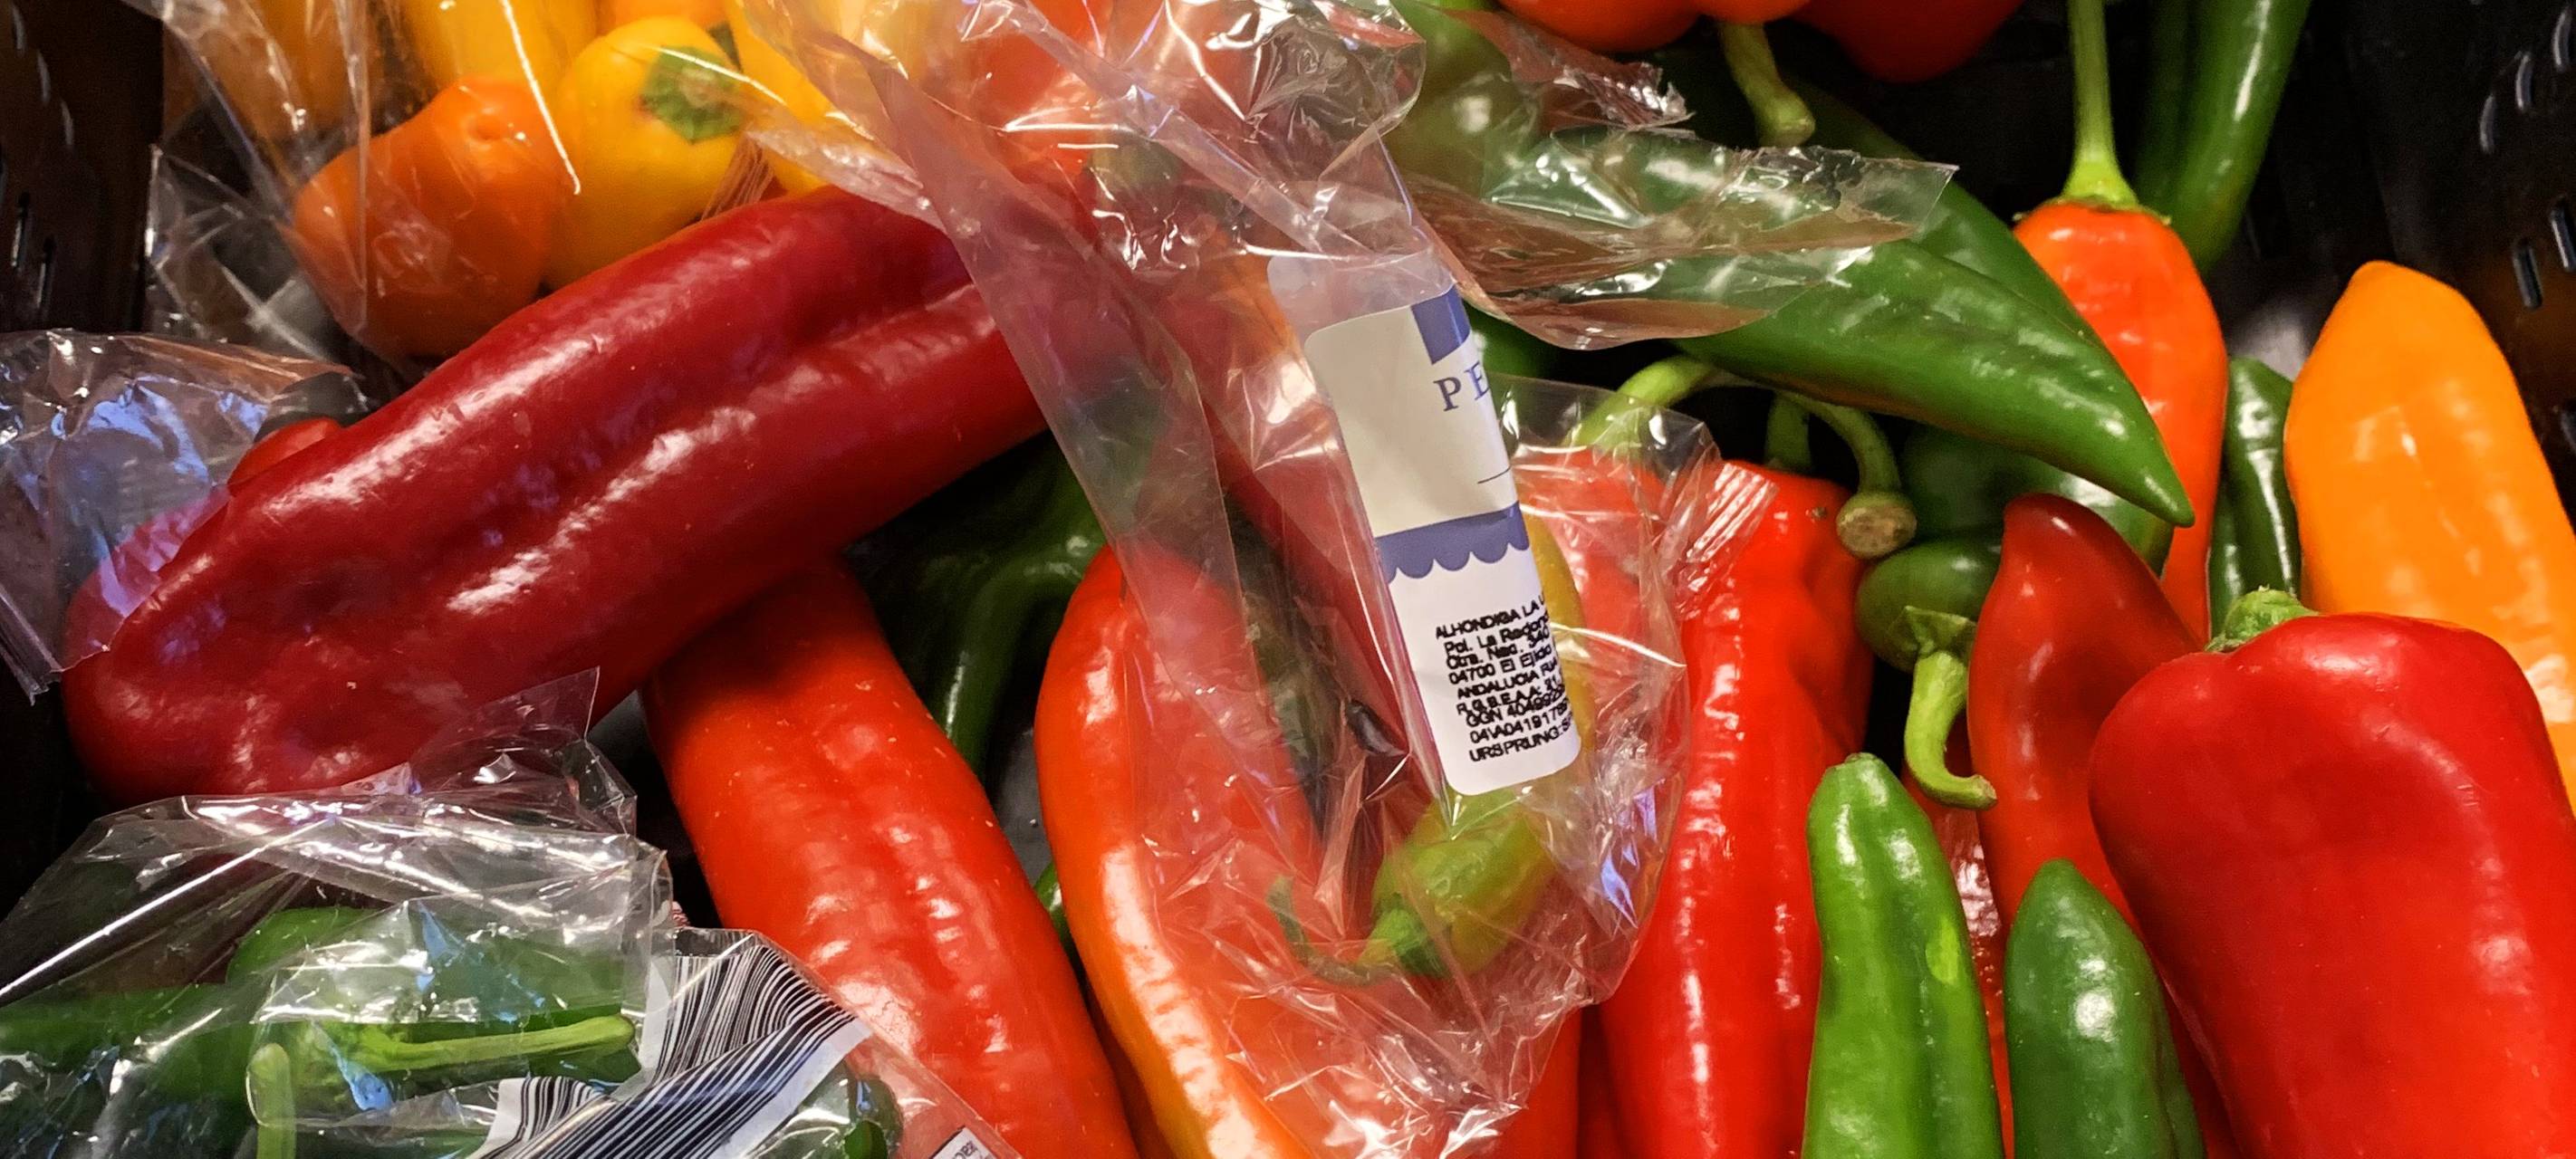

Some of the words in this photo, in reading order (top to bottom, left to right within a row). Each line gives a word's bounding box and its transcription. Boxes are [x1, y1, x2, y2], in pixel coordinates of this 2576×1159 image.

[1436, 608, 1522, 639] ALHONDIGA
[1522, 599, 1540, 618] LA
[1444, 638, 1474, 657] Pol.
[1527, 625, 1550, 648] 340
[1448, 663, 1496, 685] 04700
[1499, 657, 1516, 674] El
[1519, 644, 1552, 668] Ejido
[1457, 669, 1541, 700] ANDALUCIA
[1466, 706, 1504, 728] GGN
